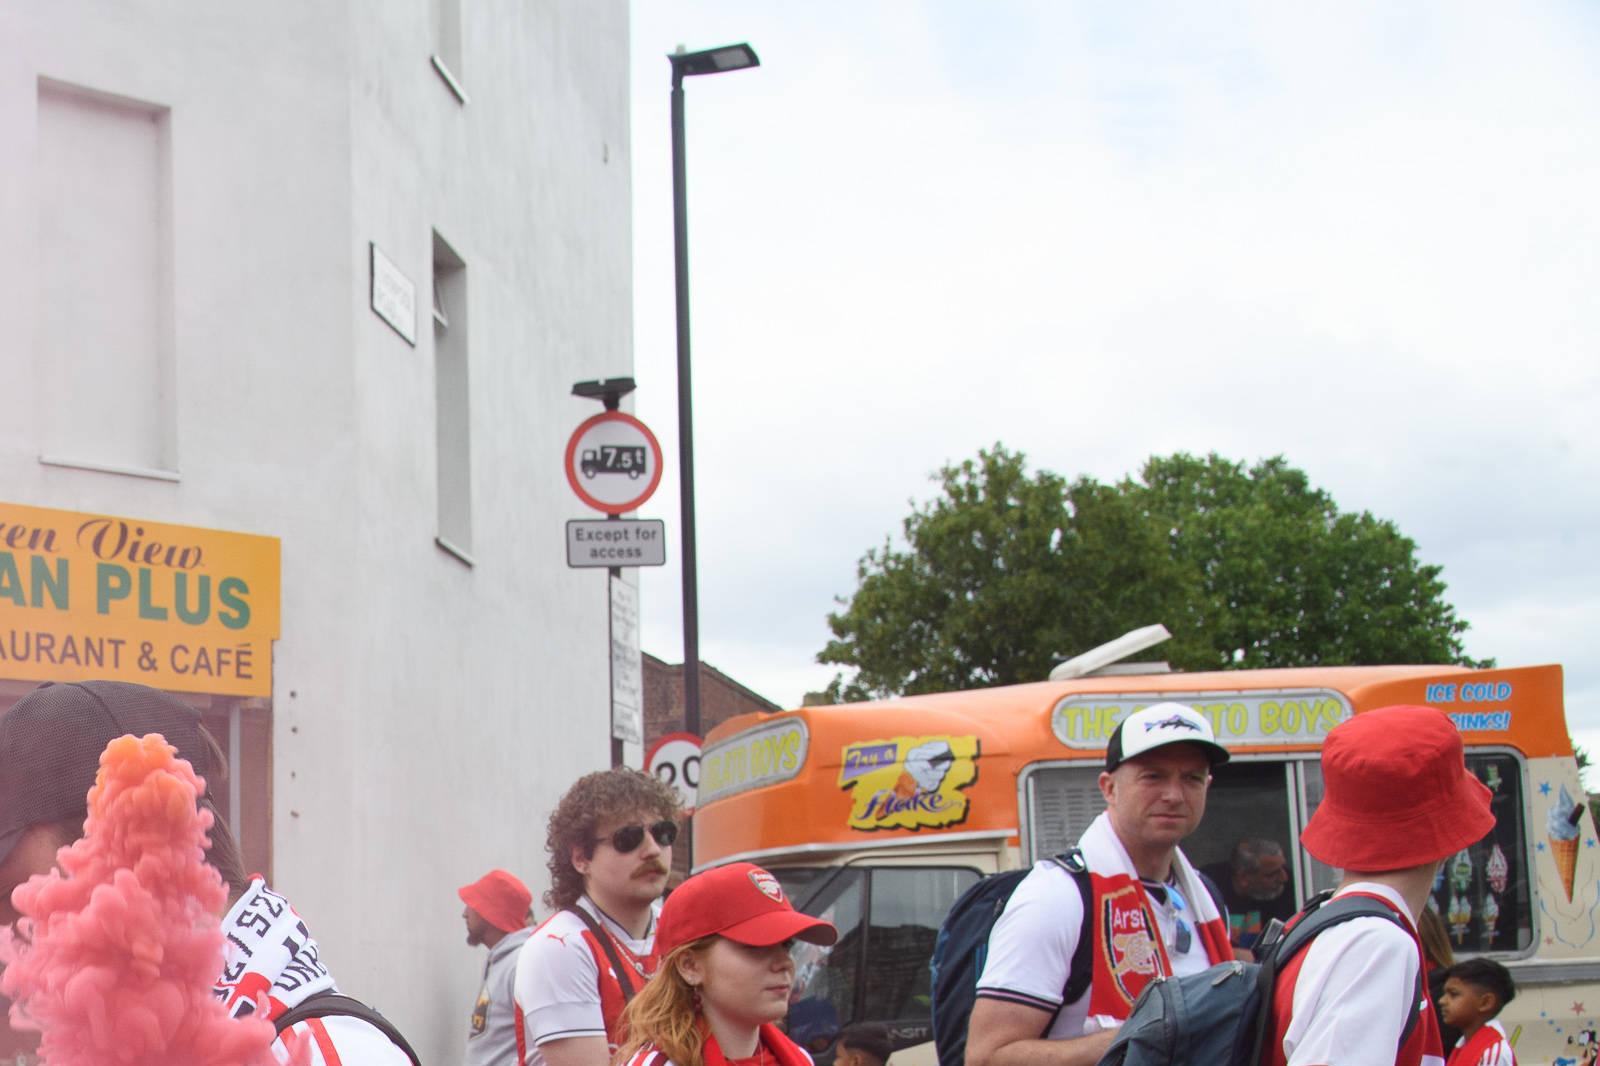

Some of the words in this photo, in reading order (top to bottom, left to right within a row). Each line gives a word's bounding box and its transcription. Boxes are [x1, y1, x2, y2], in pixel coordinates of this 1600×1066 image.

[76, 518, 205, 570] View
[575, 528, 629, 543] Except
[635, 528, 657, 541] for
[589, 545, 642, 559] access
[96, 562, 252, 630] PLUS
[138, 642, 158, 672] &
[170, 643, 253, 680] CAFÉ
[1425, 683, 1456, 702] ICE
[1460, 682, 1512, 702] COLD
[1060, 706, 1121, 741] THE
[1257, 698, 1343, 734] BOYS
[750, 729, 800, 778] BOYS
[847, 750, 878, 768] Try
[656, 755, 701, 788] 20
[855, 788, 945, 821] Flake
